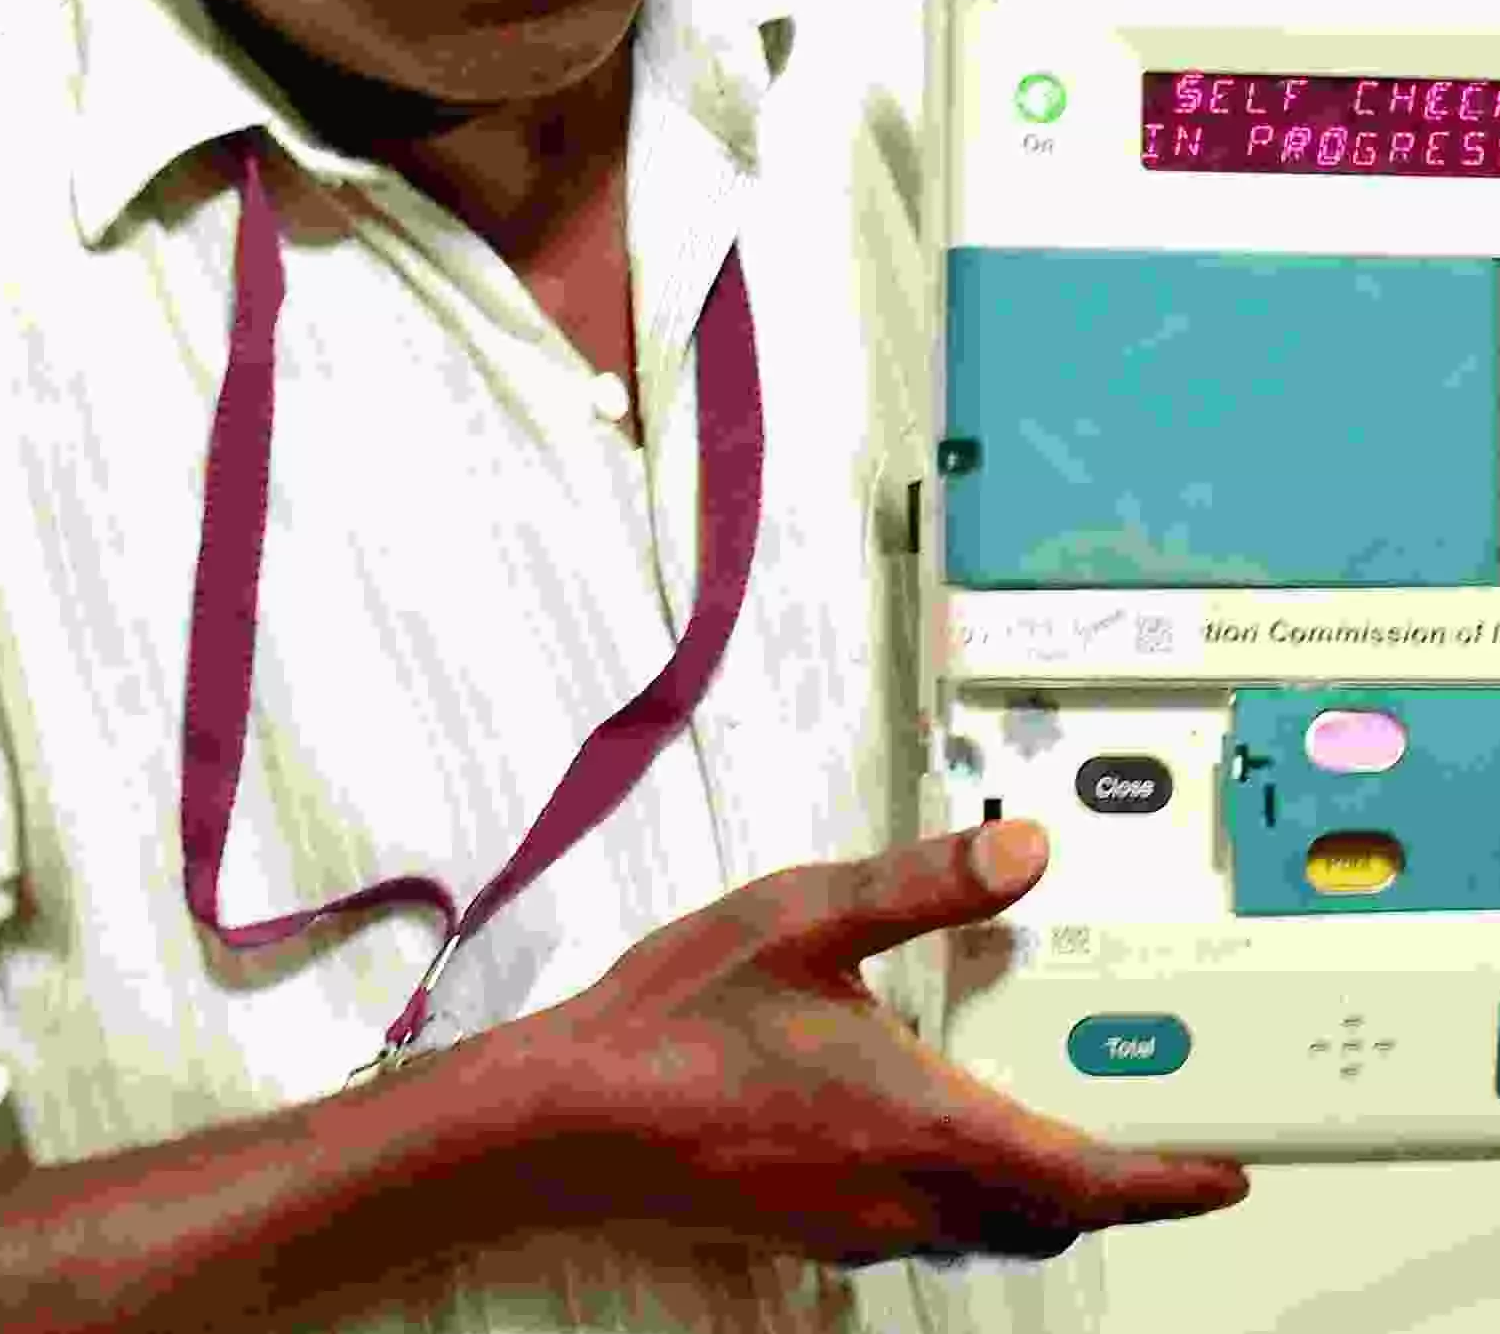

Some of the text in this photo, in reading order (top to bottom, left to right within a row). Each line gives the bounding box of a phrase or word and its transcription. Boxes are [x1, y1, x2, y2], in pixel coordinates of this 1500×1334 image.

[1173, 73, 1308, 115] SELF
[1141, 123, 1203, 162] IN
[1267, 617, 1447, 646] Commission
[1454, 619, 1484, 645] of
[1095, 776, 1155, 800] Close
